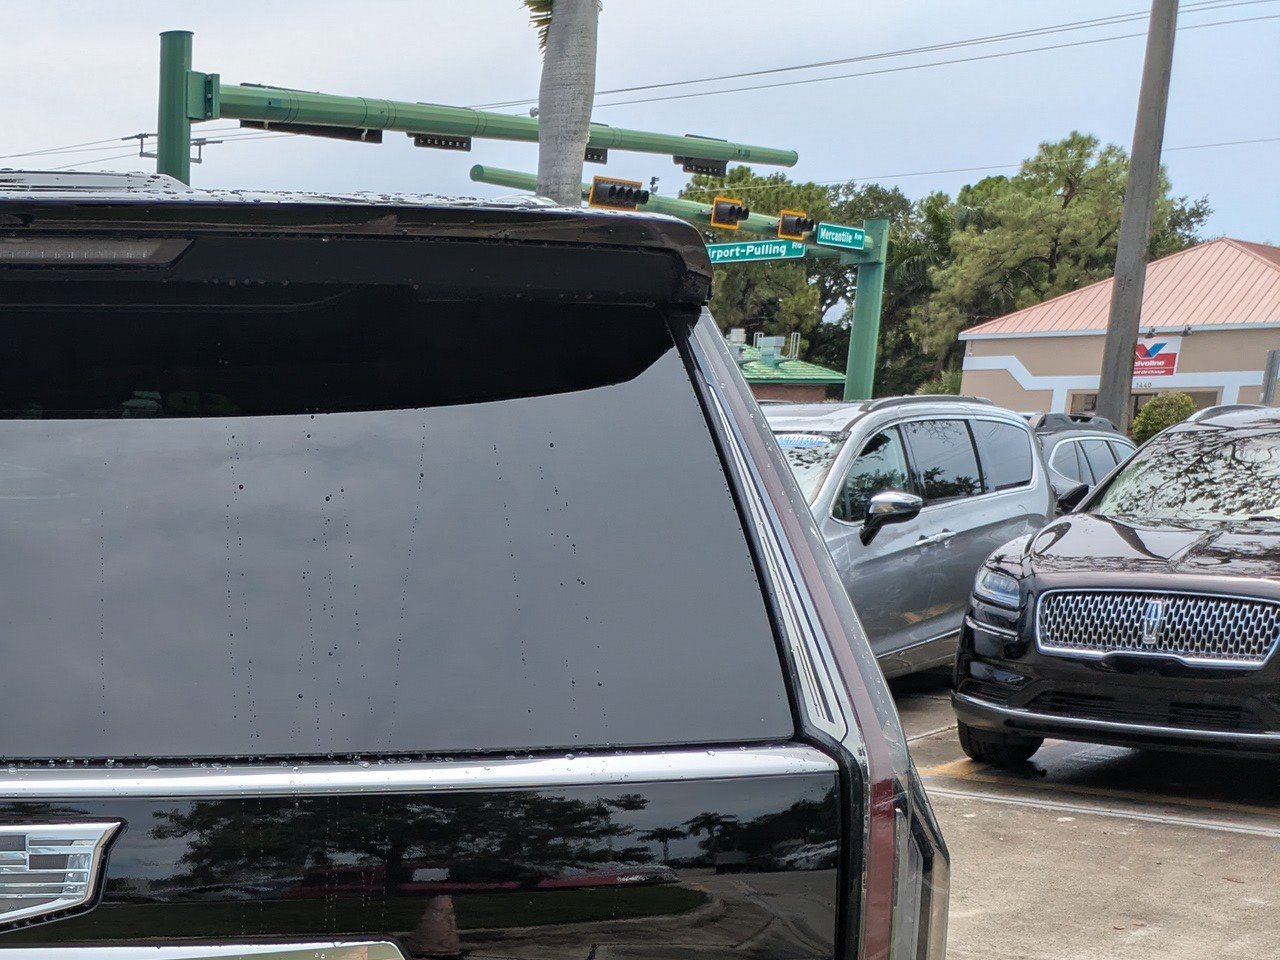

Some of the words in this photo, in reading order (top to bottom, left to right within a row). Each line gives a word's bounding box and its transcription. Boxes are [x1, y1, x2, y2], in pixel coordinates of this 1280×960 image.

[820, 229, 852, 243] Mercantile
[854, 232, 863, 241] Ave
[708, 244, 786, 260] irport-Pulling
